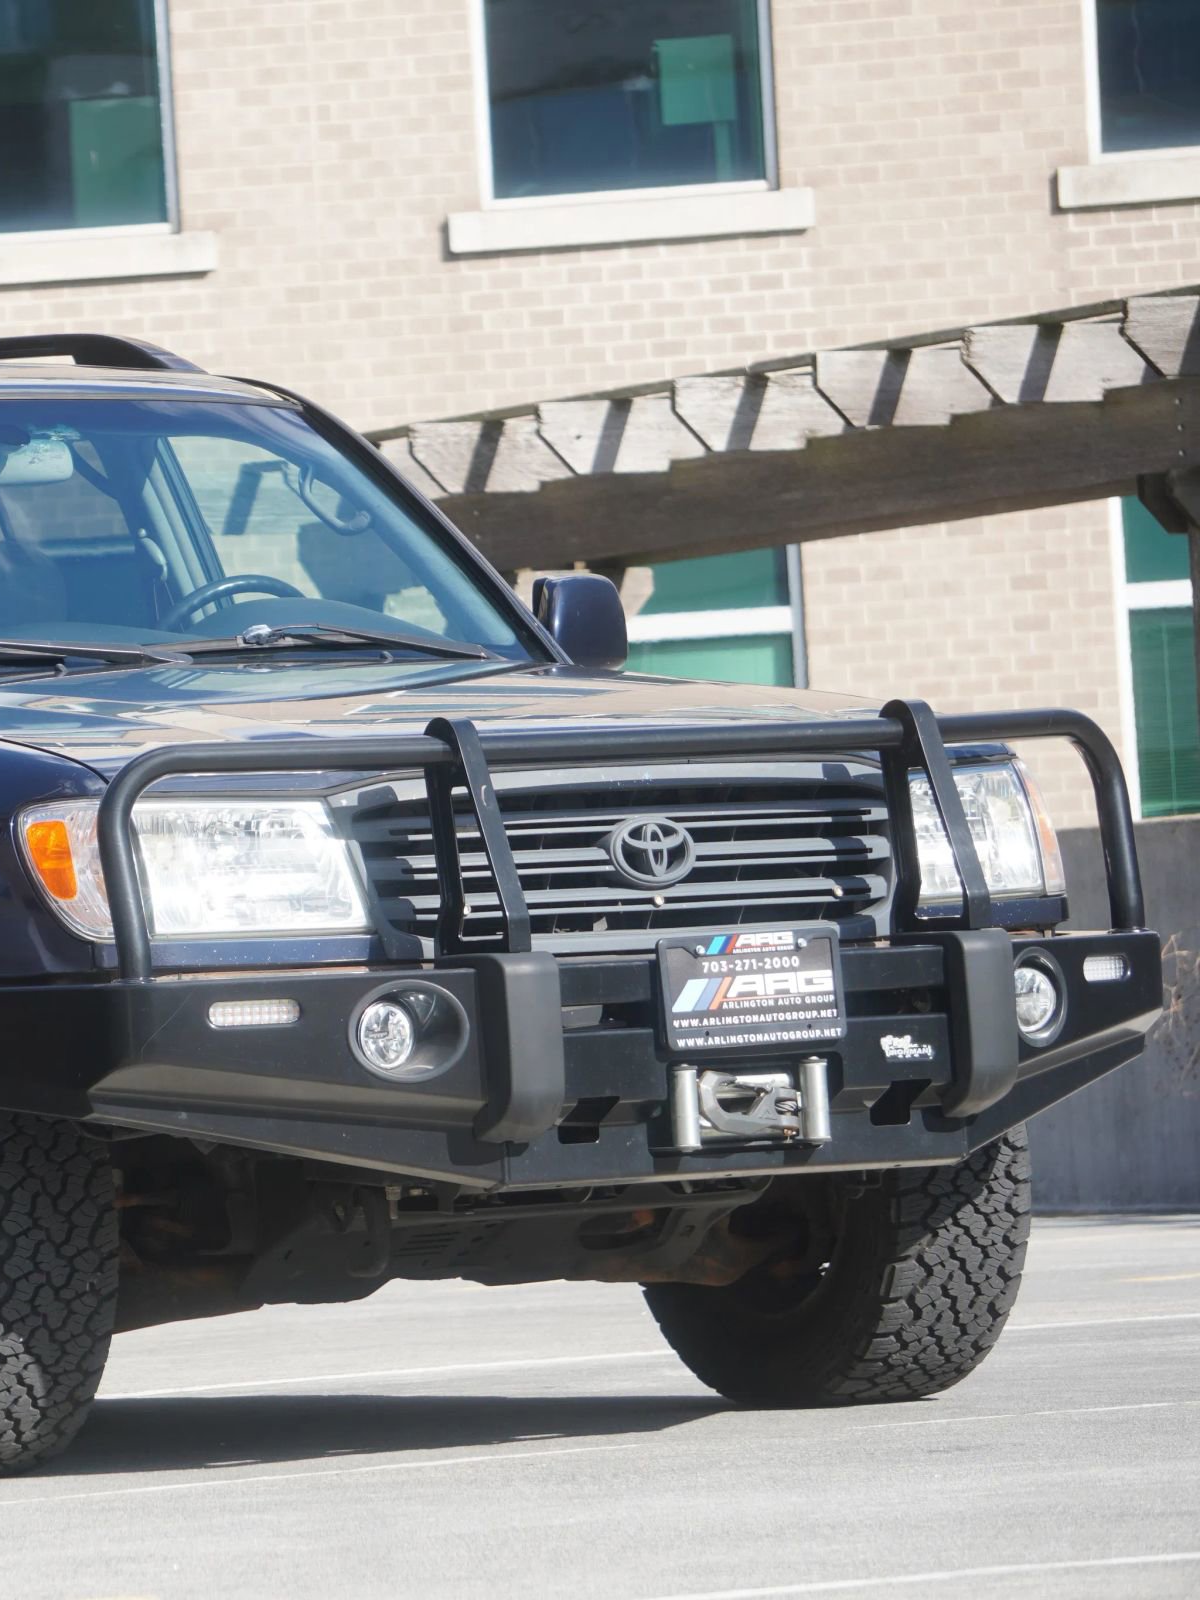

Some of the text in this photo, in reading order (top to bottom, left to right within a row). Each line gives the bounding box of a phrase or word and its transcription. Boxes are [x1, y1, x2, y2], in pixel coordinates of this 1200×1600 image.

[734, 931, 794, 948] AAG
[702, 956, 799, 973] 703-271-2000
[726, 969, 834, 998] AAG
[722, 994, 835, 1009] ARLINGTON AUTO GROUP
[677, 1028, 842, 1047] WWW.ARLINGTONAUTOGROUP.NET
